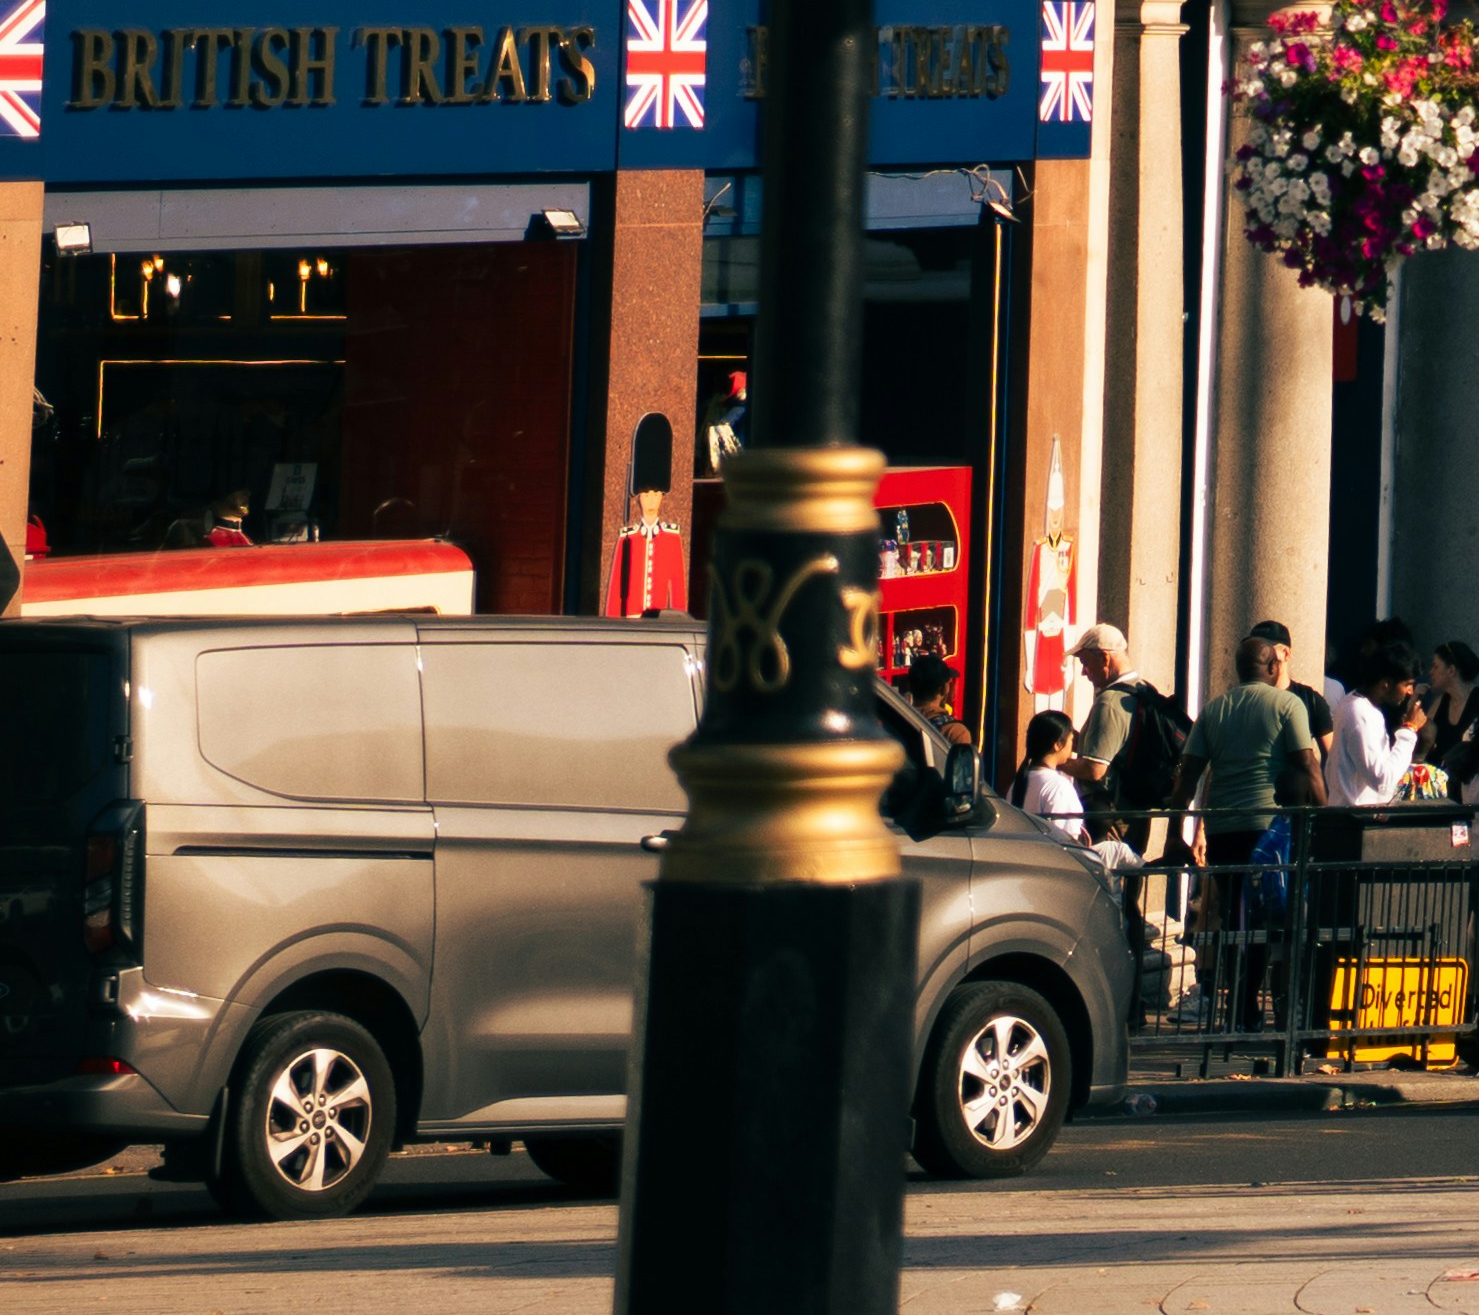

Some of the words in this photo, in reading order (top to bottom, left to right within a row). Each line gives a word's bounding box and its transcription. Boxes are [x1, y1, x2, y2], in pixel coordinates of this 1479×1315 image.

[62, 26, 342, 112] BRITISH
[350, 24, 598, 109] TREATS
[1360, 982, 1453, 1011] Diverted
